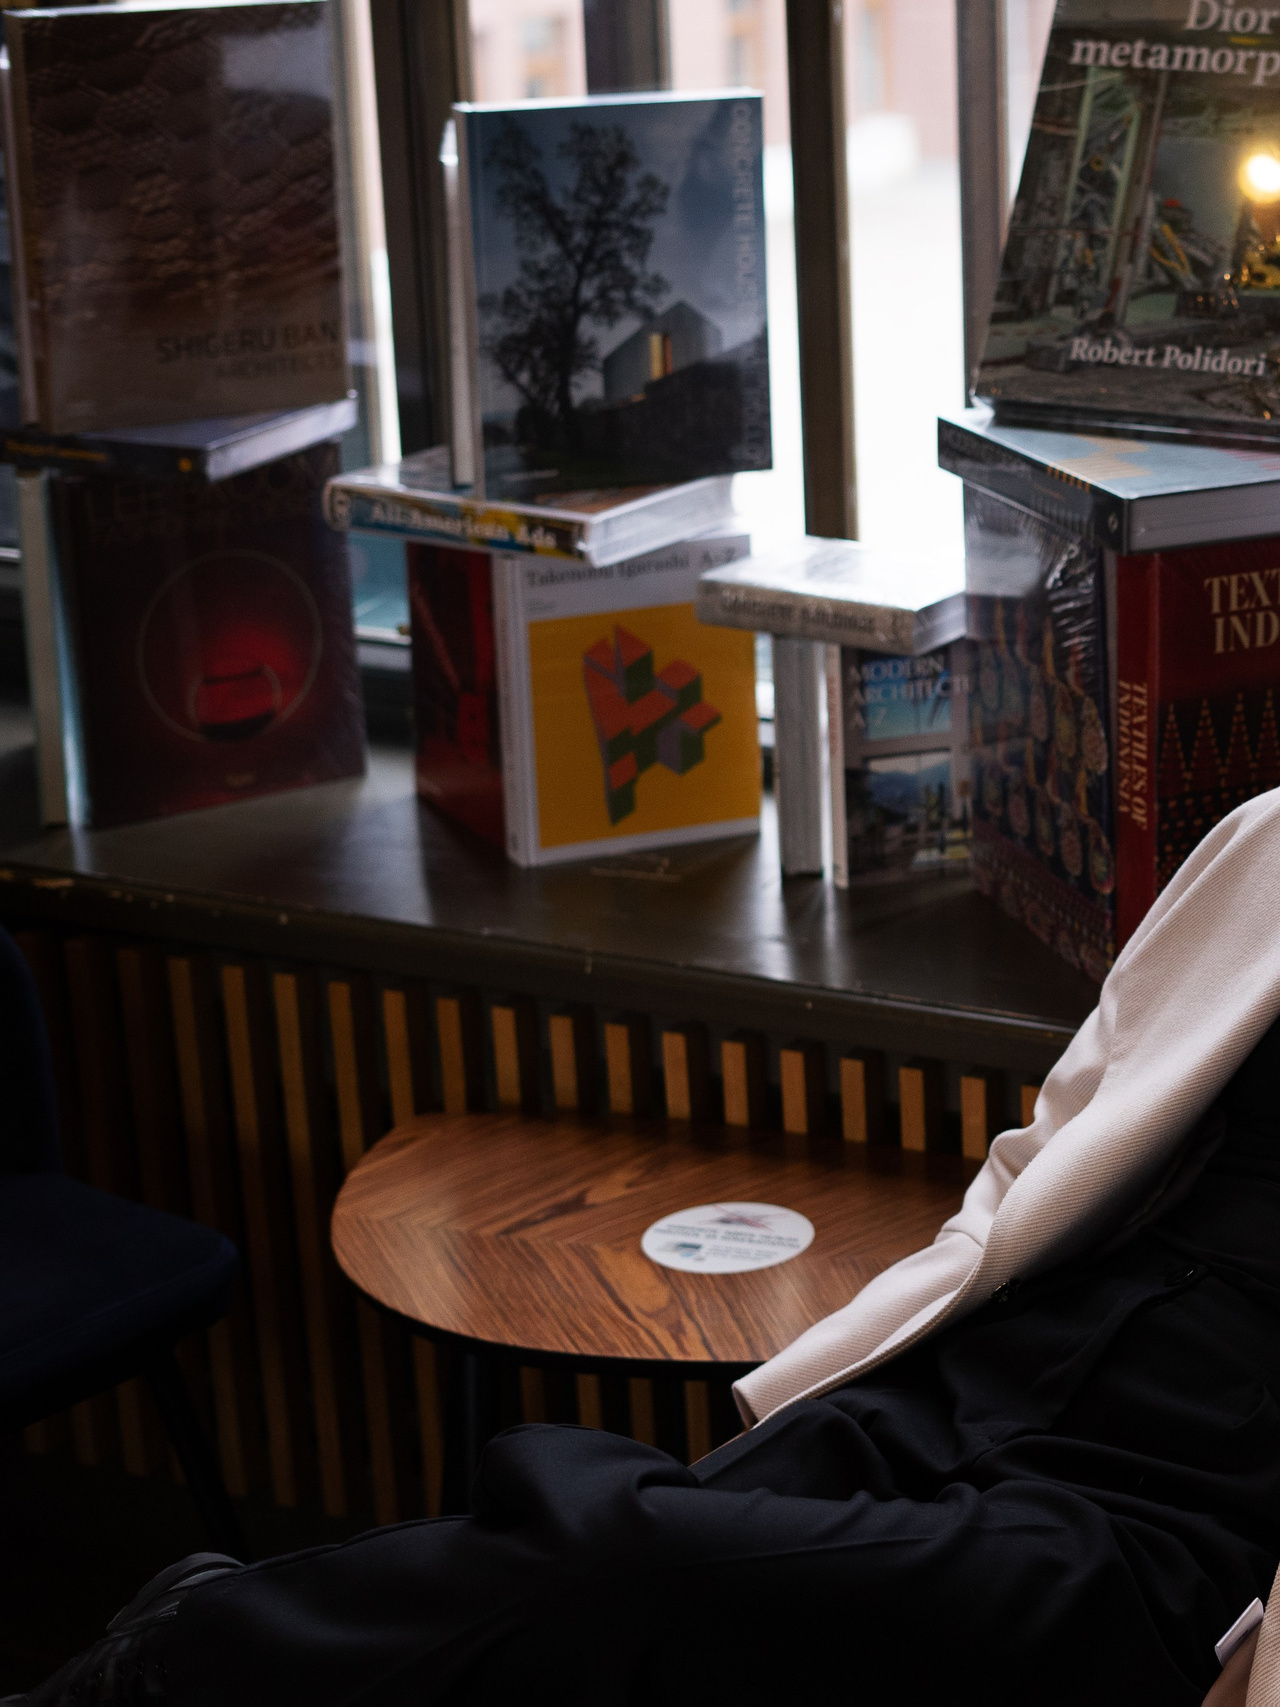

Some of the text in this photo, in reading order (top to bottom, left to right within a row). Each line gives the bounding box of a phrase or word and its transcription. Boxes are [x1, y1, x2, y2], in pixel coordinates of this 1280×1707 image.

[1184, 0, 1280, 34] Dior
[156, 319, 339, 363] SHIGERU BAN
[1069, 336, 1268, 377] Robert Polidori
[1116, 680, 1131, 813] INDONESIA
[1130, 682, 1148, 831] TEXTILES OF
